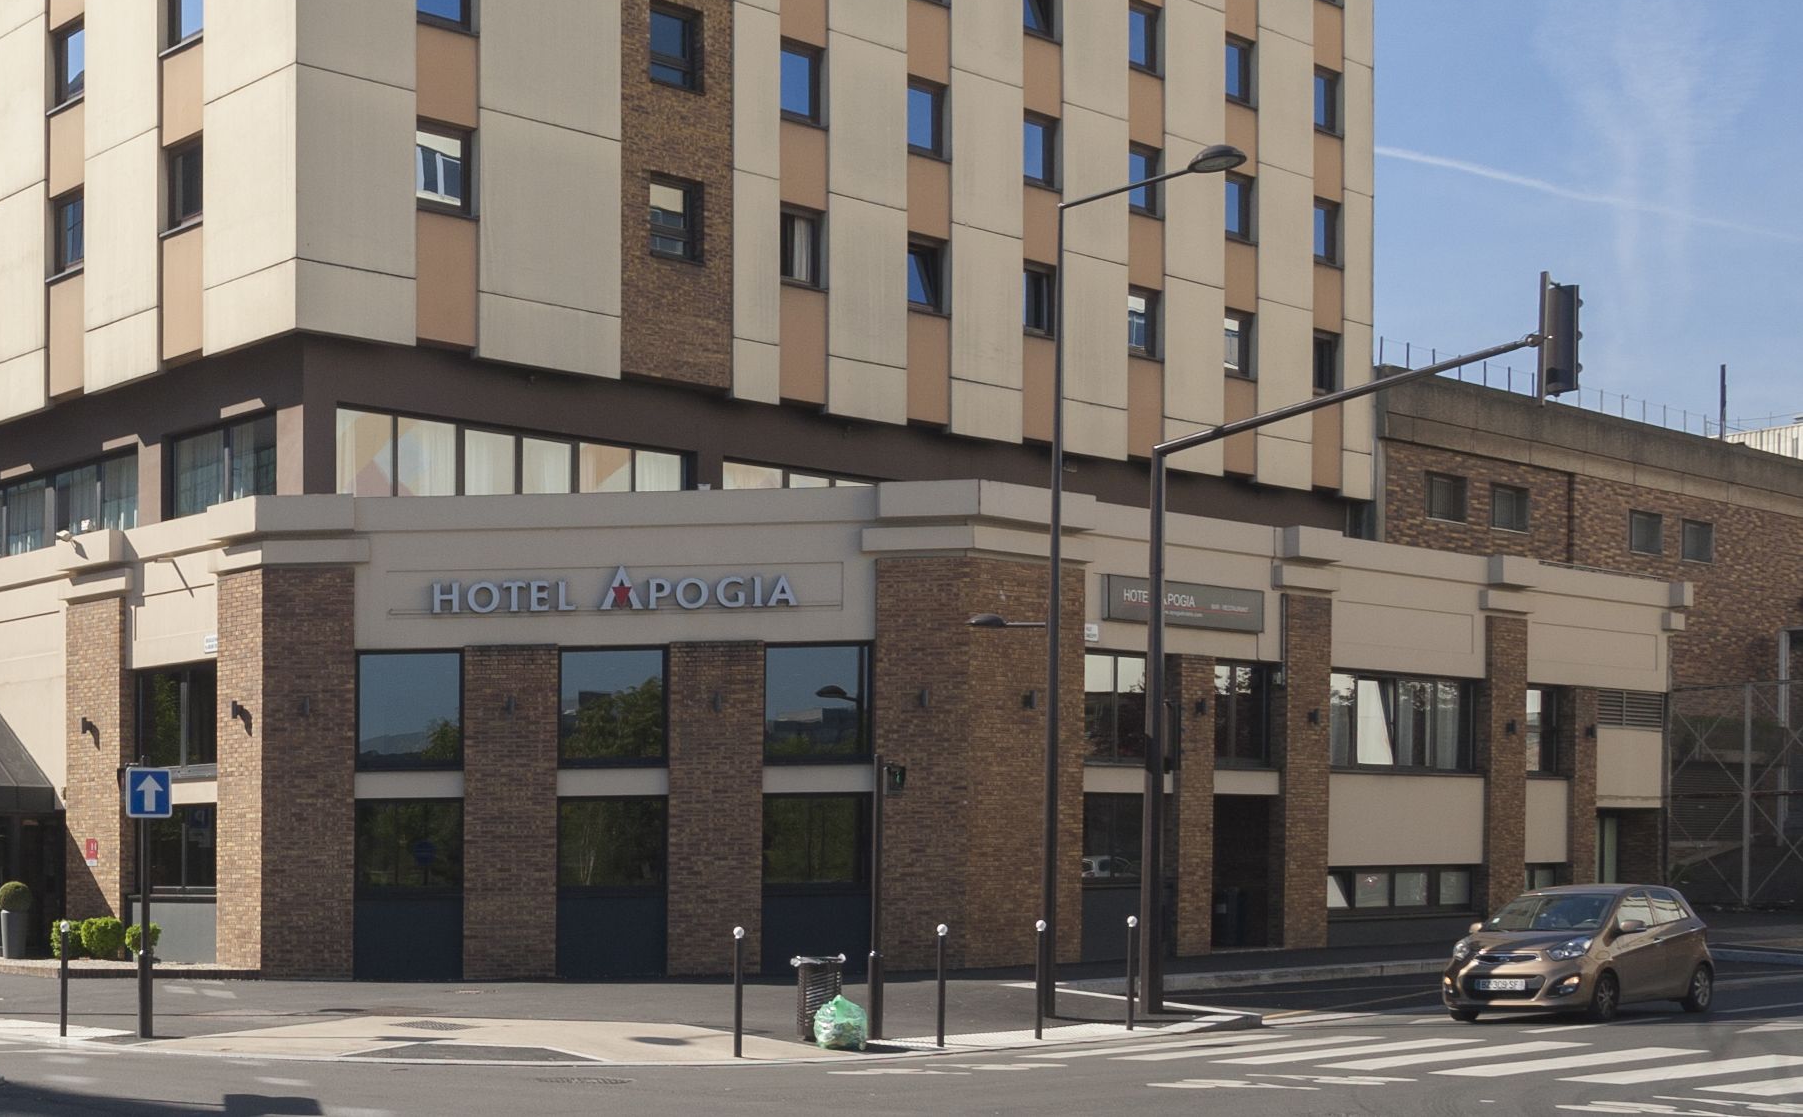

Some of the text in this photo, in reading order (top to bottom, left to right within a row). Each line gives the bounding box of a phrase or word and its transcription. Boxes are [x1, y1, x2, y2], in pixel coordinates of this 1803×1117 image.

[432, 565, 798, 613] HOTEL APOGIA
[1123, 588, 1149, 603] HOTE
